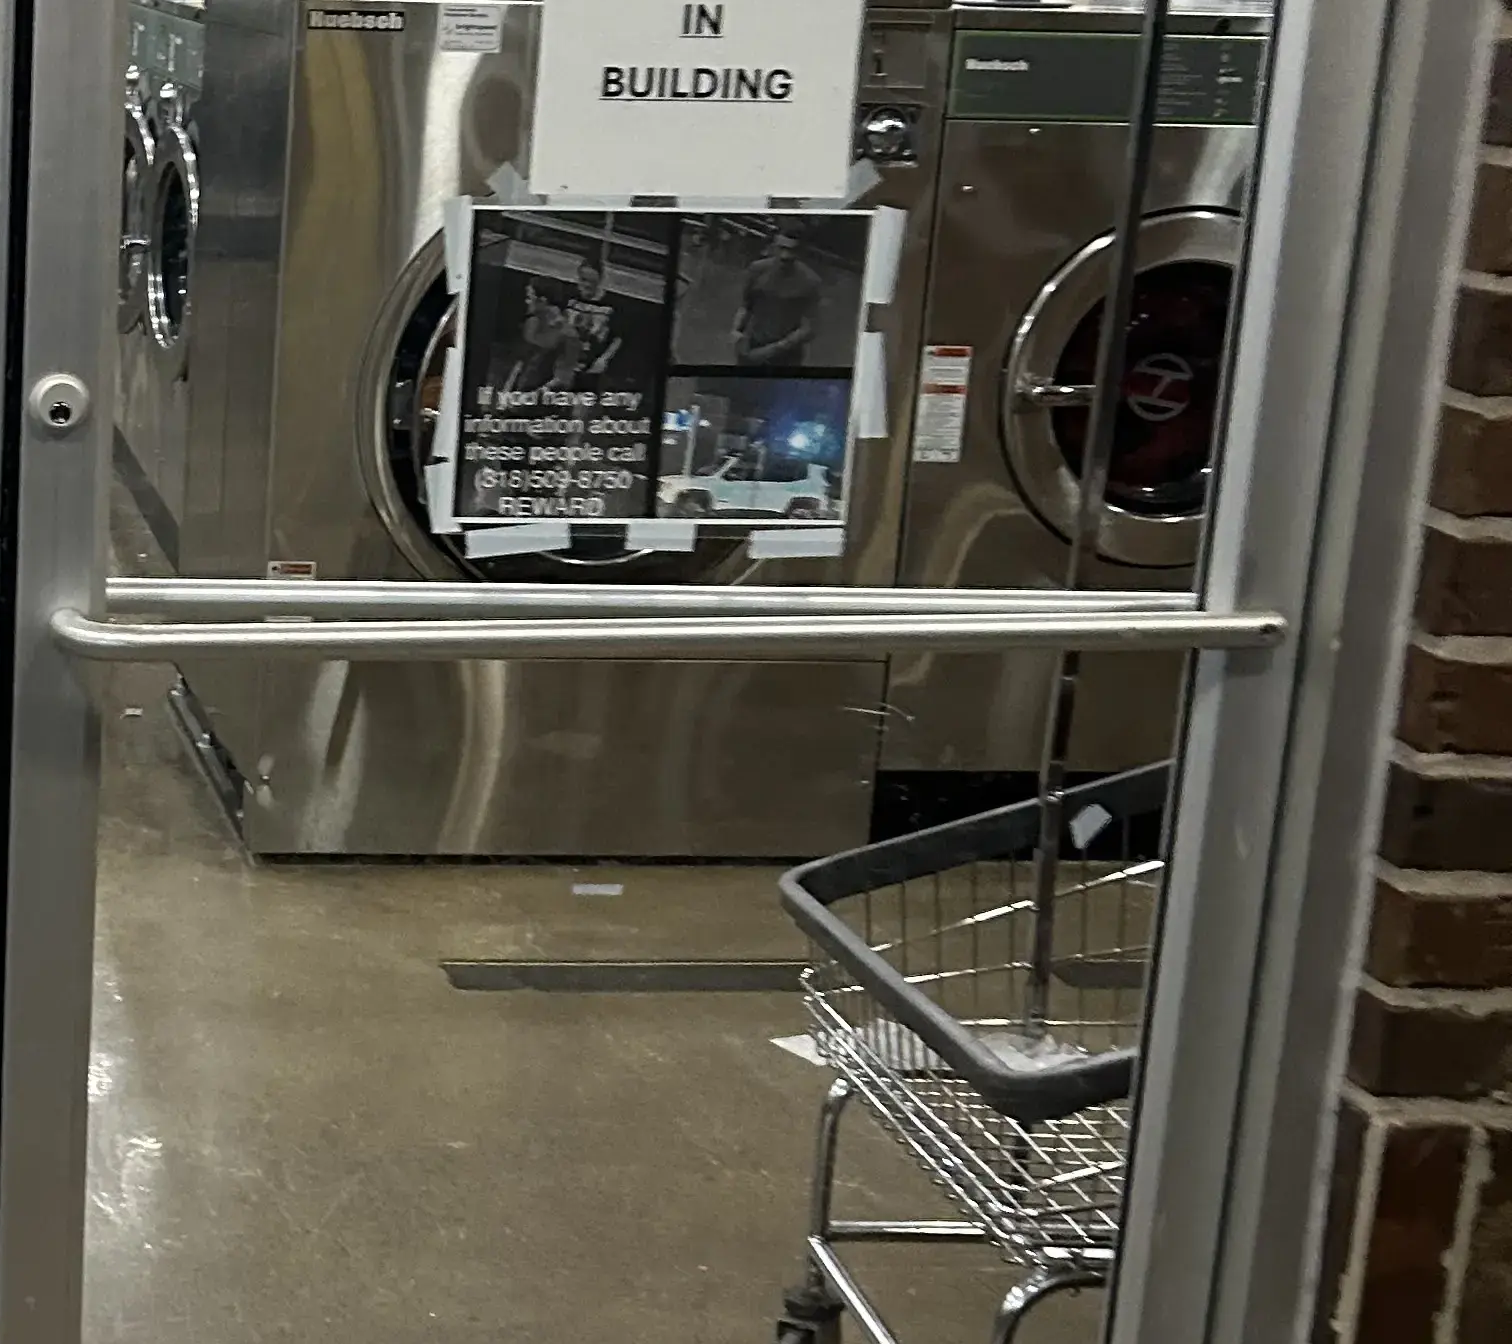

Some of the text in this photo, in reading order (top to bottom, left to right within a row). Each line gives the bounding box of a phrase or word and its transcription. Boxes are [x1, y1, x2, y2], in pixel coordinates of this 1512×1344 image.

[682, 4, 725, 36] IN
[601, 66, 794, 99] BUILDING
[476, 386, 643, 411] If you have any
[464, 414, 652, 434] information about
[464, 442, 647, 465] these people call
[498, 496, 606, 517] REWARD
